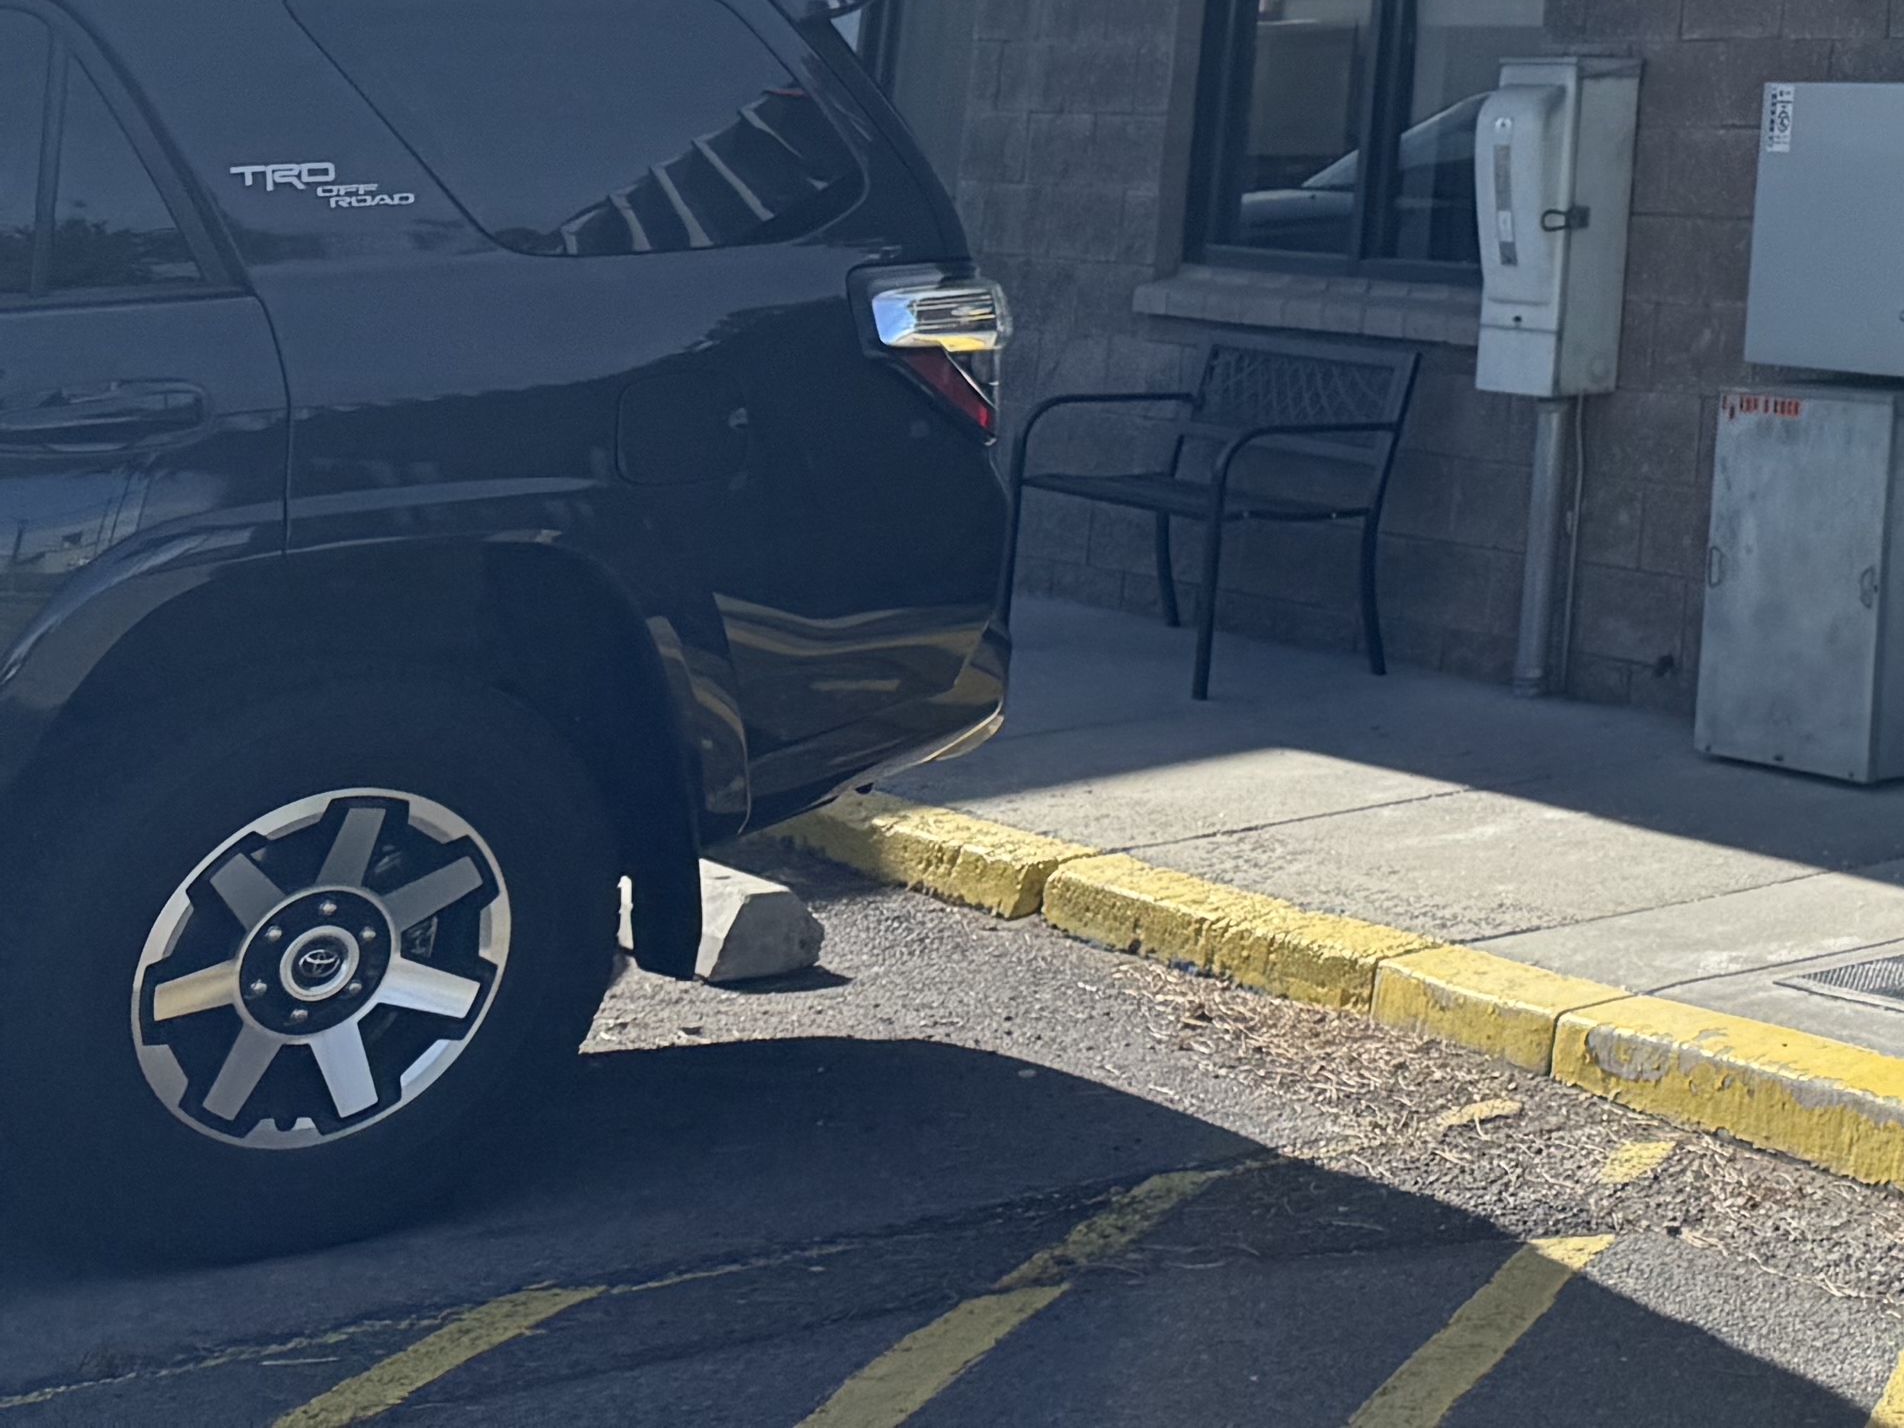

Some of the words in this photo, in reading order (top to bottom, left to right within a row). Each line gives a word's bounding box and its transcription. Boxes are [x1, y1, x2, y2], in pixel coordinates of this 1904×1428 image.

[229, 162, 335, 191] TRD
[316, 183, 378, 197] OFF
[330, 193, 415, 208] ROAD
